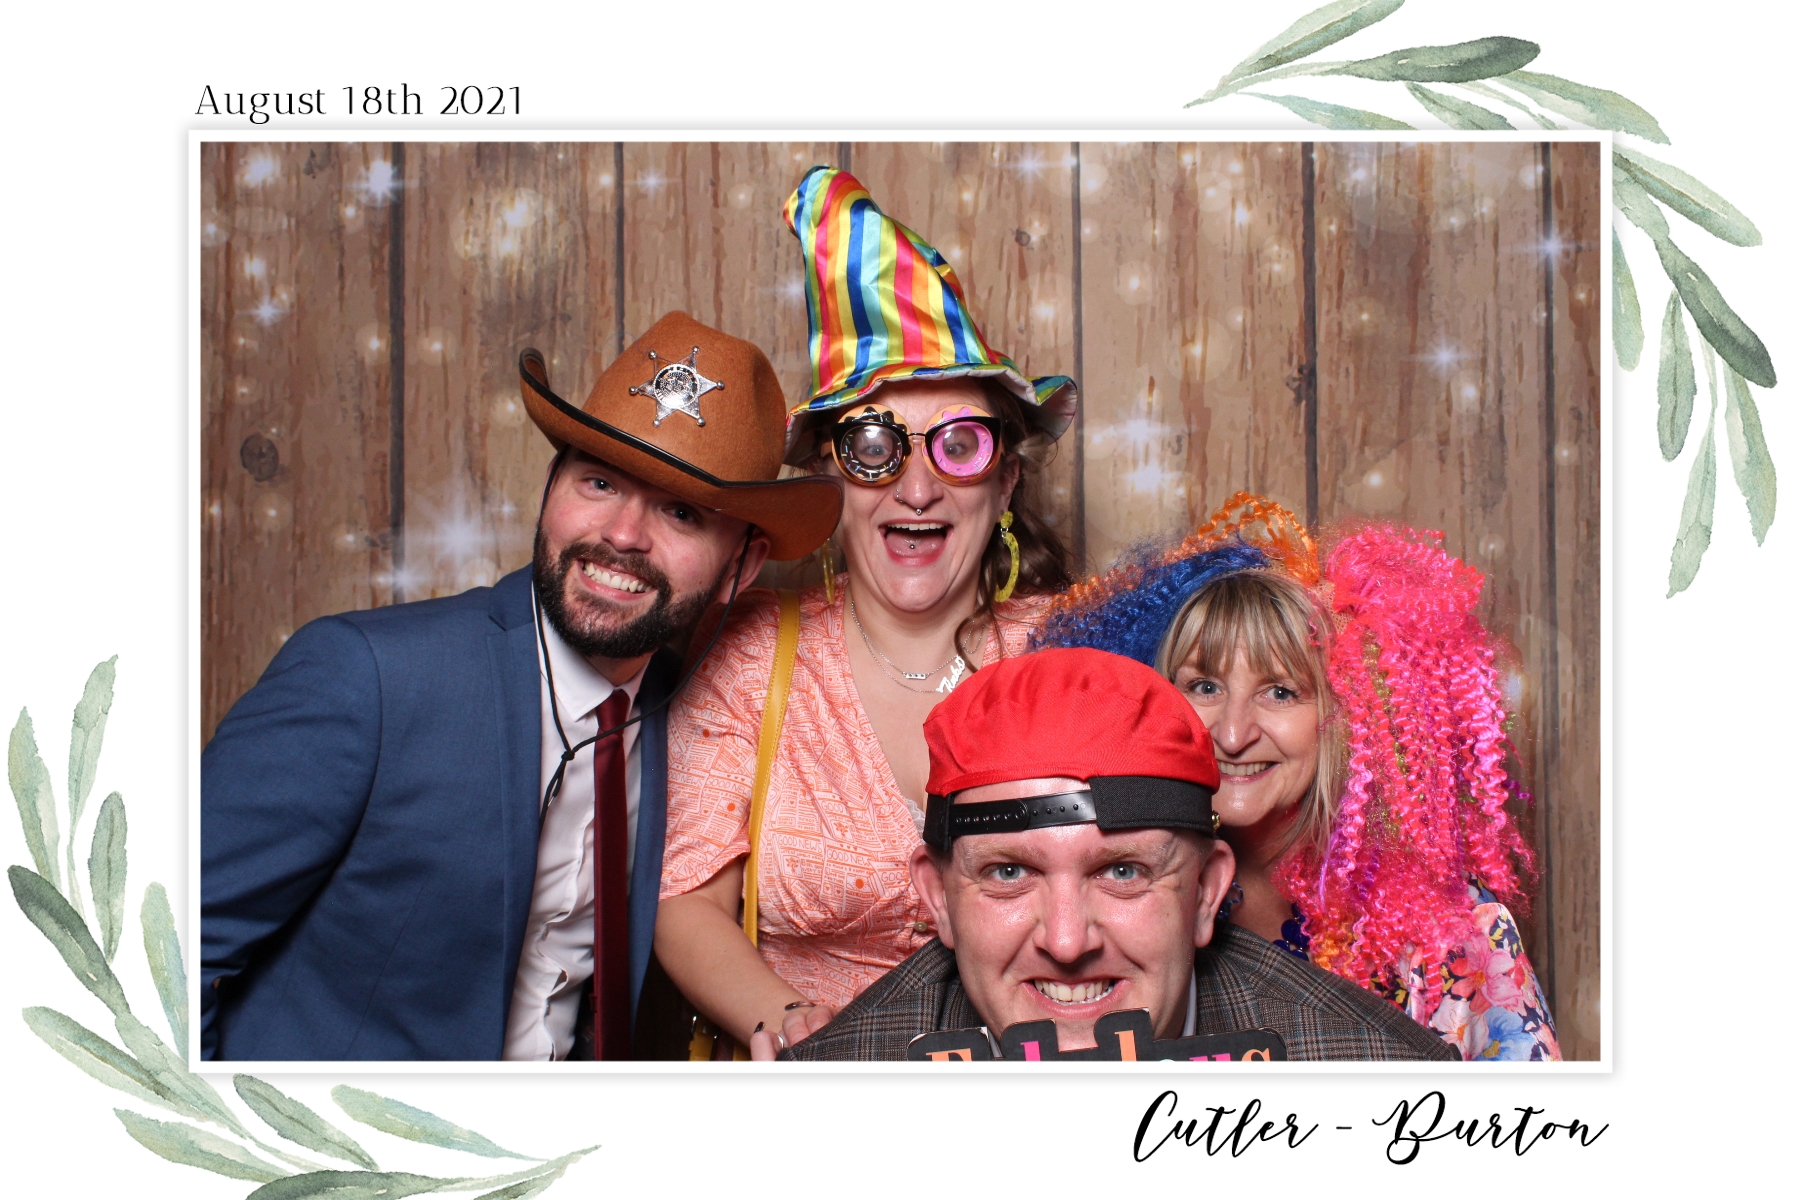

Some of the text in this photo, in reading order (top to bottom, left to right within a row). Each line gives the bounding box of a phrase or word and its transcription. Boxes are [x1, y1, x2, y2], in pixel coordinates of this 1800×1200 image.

[820, 800, 844, 813] GOOD
[778, 834, 798, 847] GOOD
[799, 839, 823, 854] NEWS
[826, 849, 849, 862] GOOD
